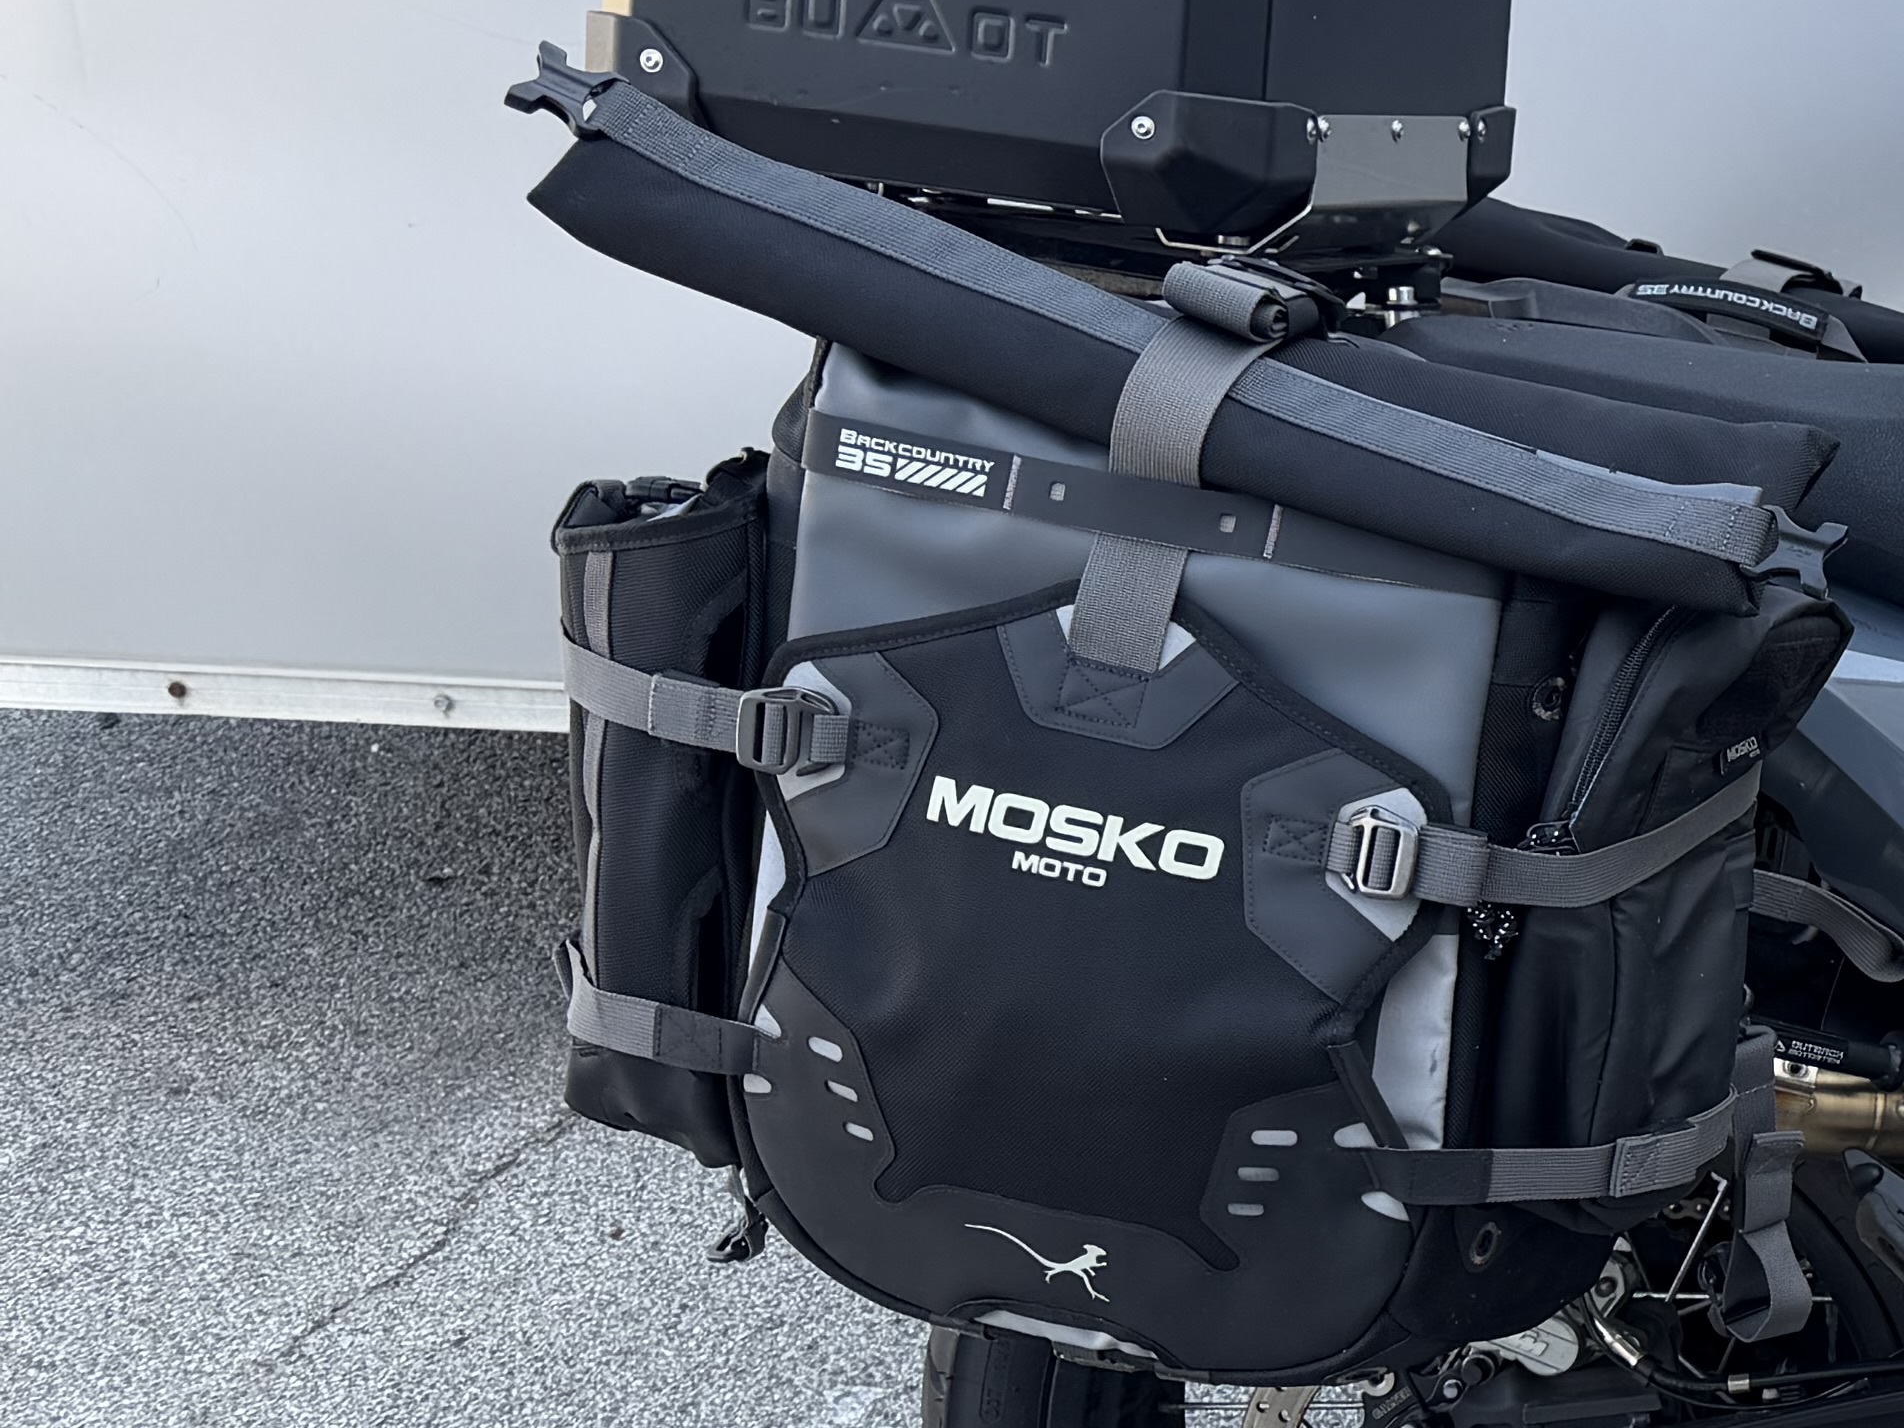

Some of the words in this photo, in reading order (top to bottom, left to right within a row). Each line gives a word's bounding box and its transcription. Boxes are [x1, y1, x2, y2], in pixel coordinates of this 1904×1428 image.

[1669, 284, 1818, 330] BACKCOUNTRY
[835, 444, 894, 477] 35
[839, 428, 995, 471] BACKCOUNTRY
[926, 775, 1225, 881] MOSKO
[1011, 851, 1108, 887] MOTO
